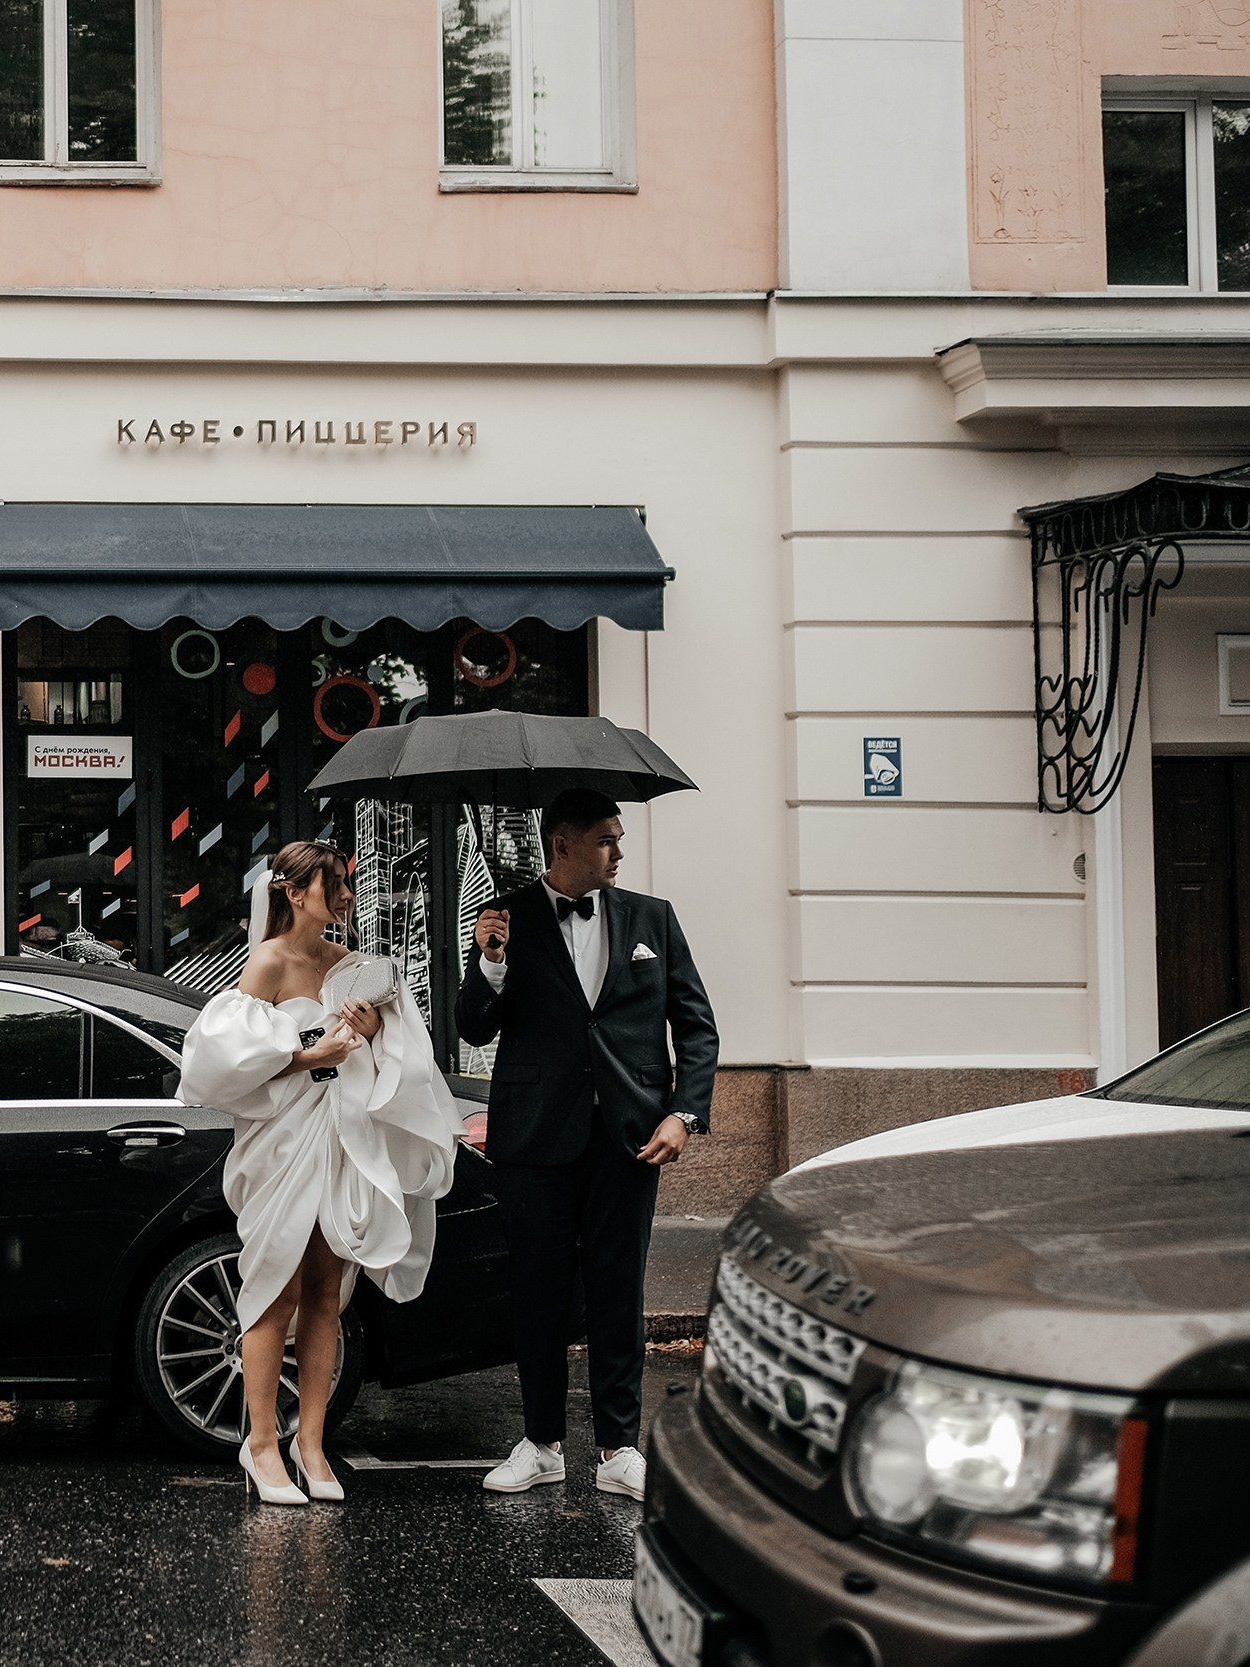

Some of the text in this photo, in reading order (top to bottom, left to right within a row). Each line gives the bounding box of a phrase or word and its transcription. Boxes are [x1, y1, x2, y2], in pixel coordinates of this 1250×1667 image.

[117, 419, 478, 446] КАФЕ ПИЦЦЕРИЯ
[43, 746, 65, 754] днём
[67, 747, 110, 755] рождения,
[34, 755, 125, 767] МОСКВА!
